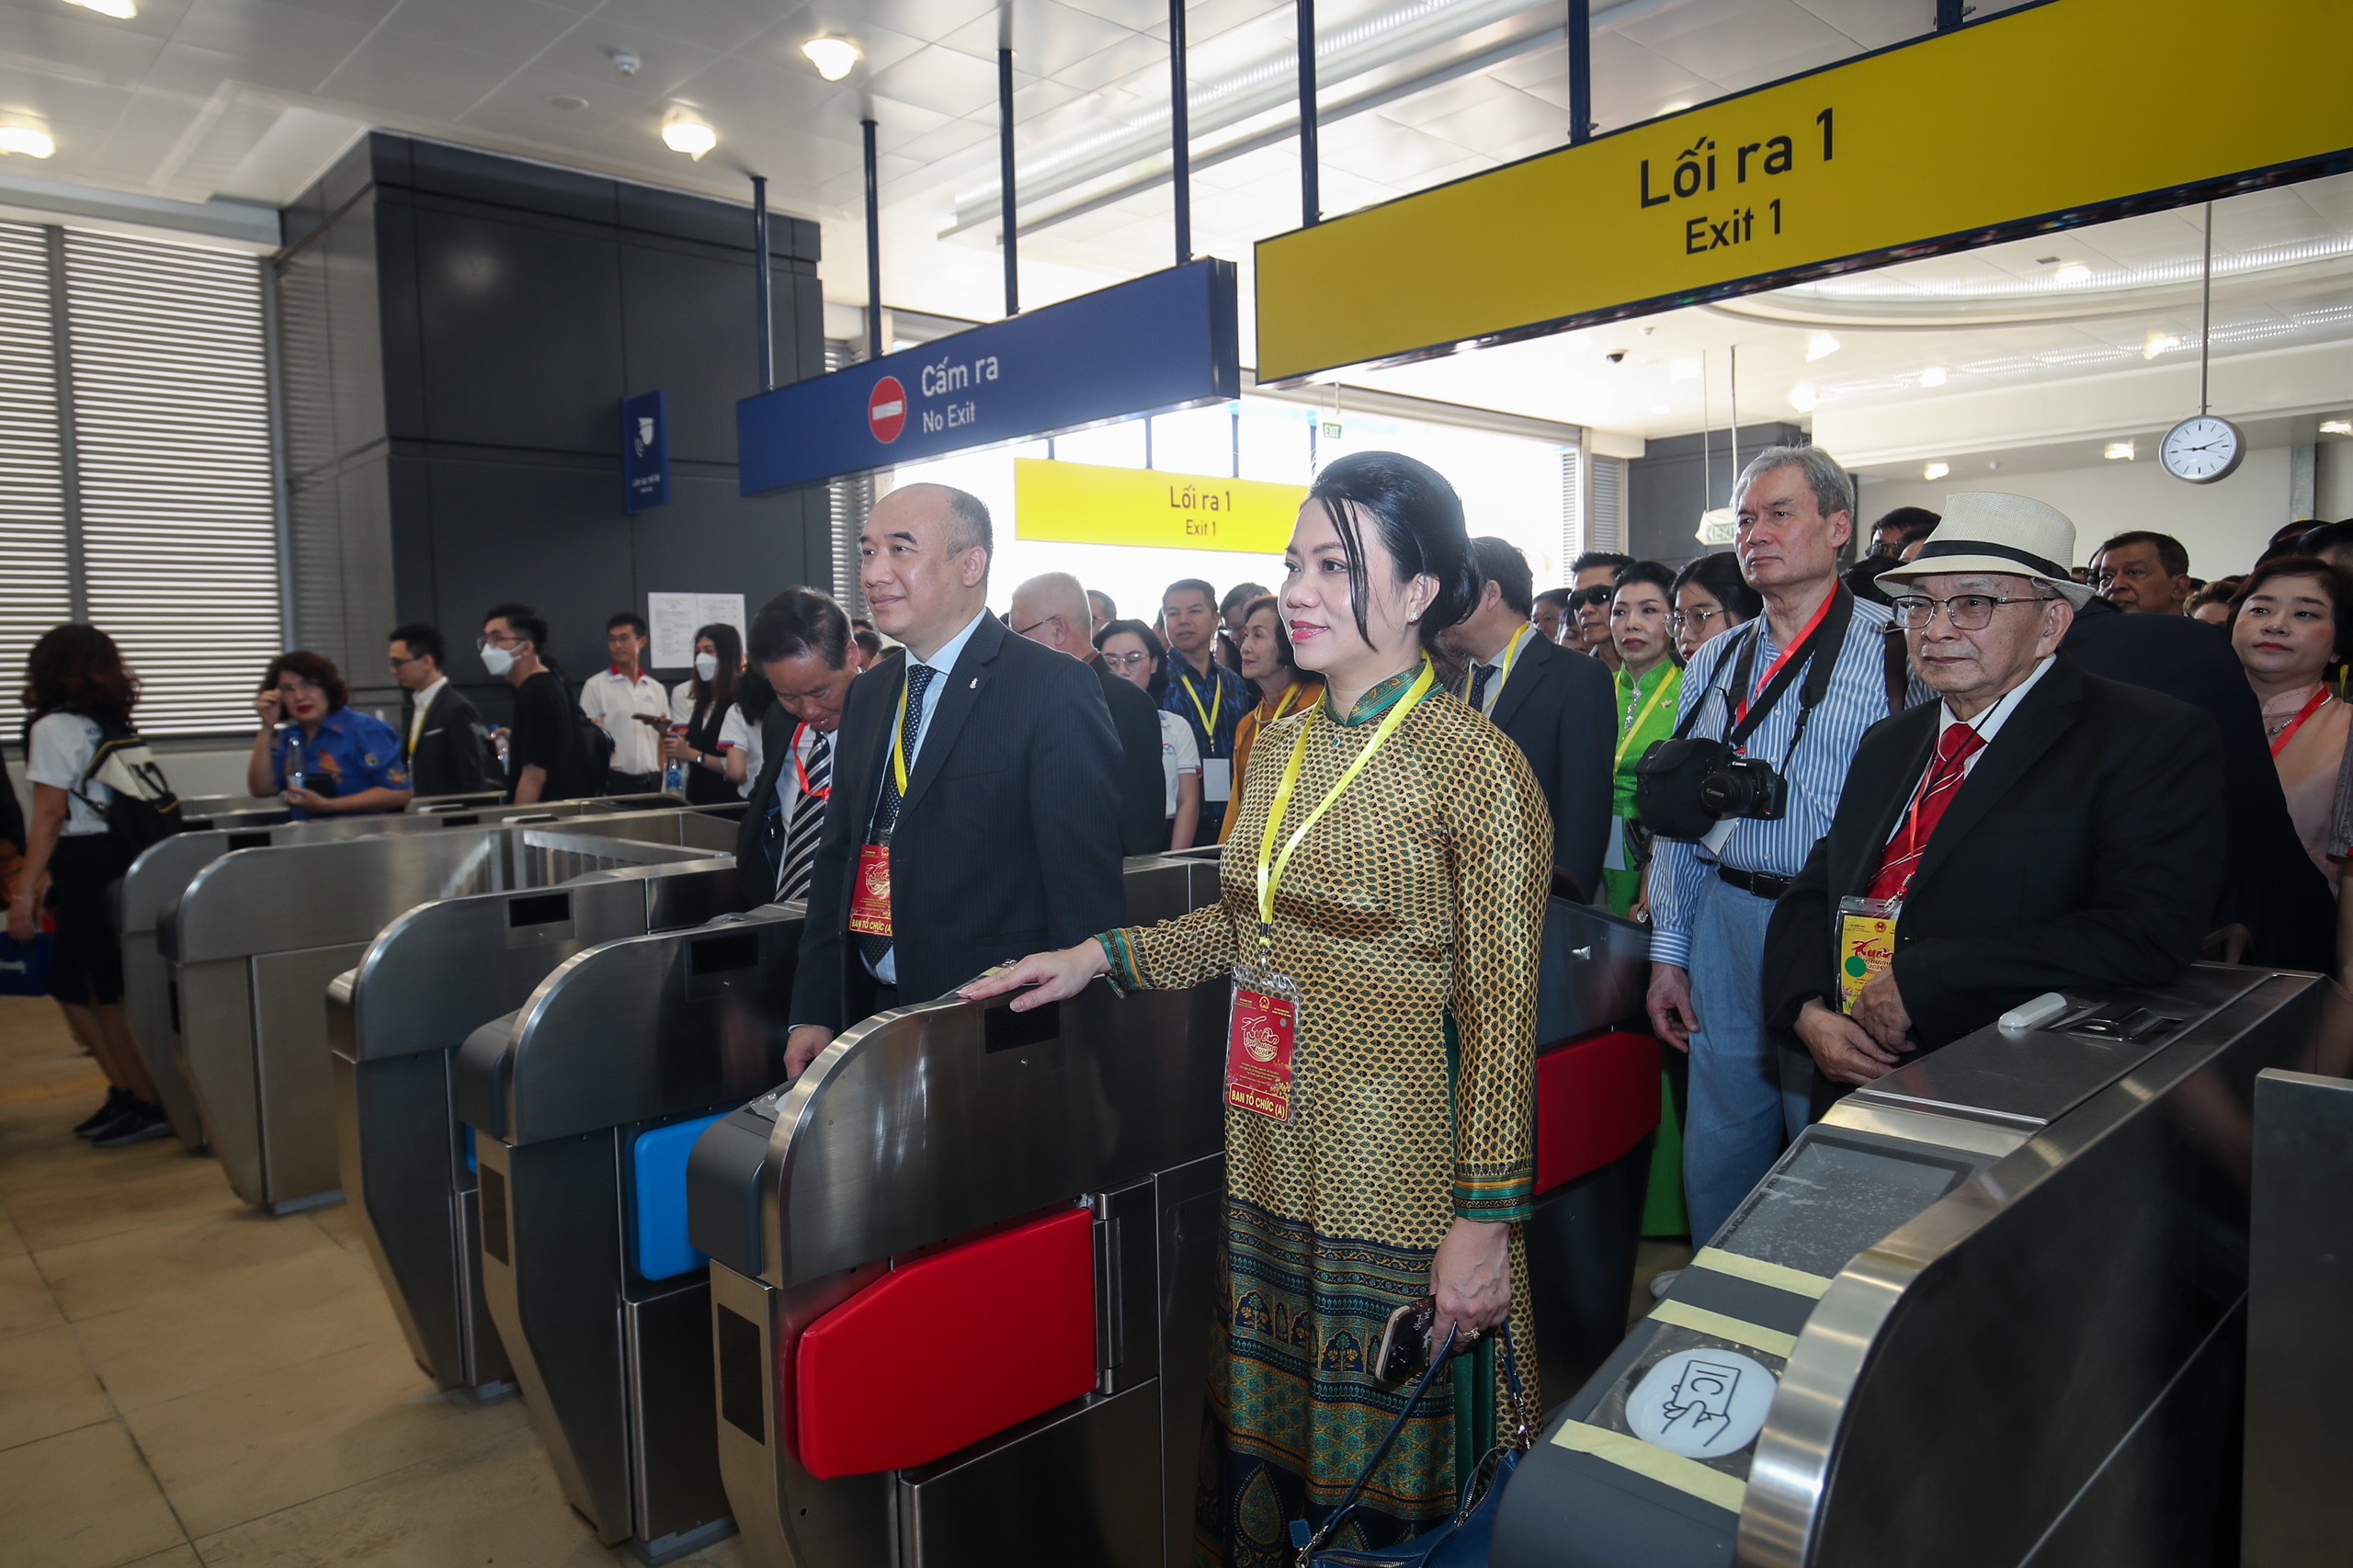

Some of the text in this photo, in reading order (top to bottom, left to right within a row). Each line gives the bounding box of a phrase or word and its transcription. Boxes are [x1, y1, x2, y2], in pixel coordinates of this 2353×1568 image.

[1641, 108, 1833, 209] Lối ra 1
[1686, 198, 1780, 255] Exit 1
[921, 356, 998, 397] Cấm ra
[923, 401, 975, 434] No Exit
[1170, 484, 1230, 512] Lối ra 1
[1186, 519, 1216, 536] Exit 1
[1707, 788, 1724, 798] Canon
[1232, 1090, 1285, 1119] BAN TỔ CHỨC (A)
